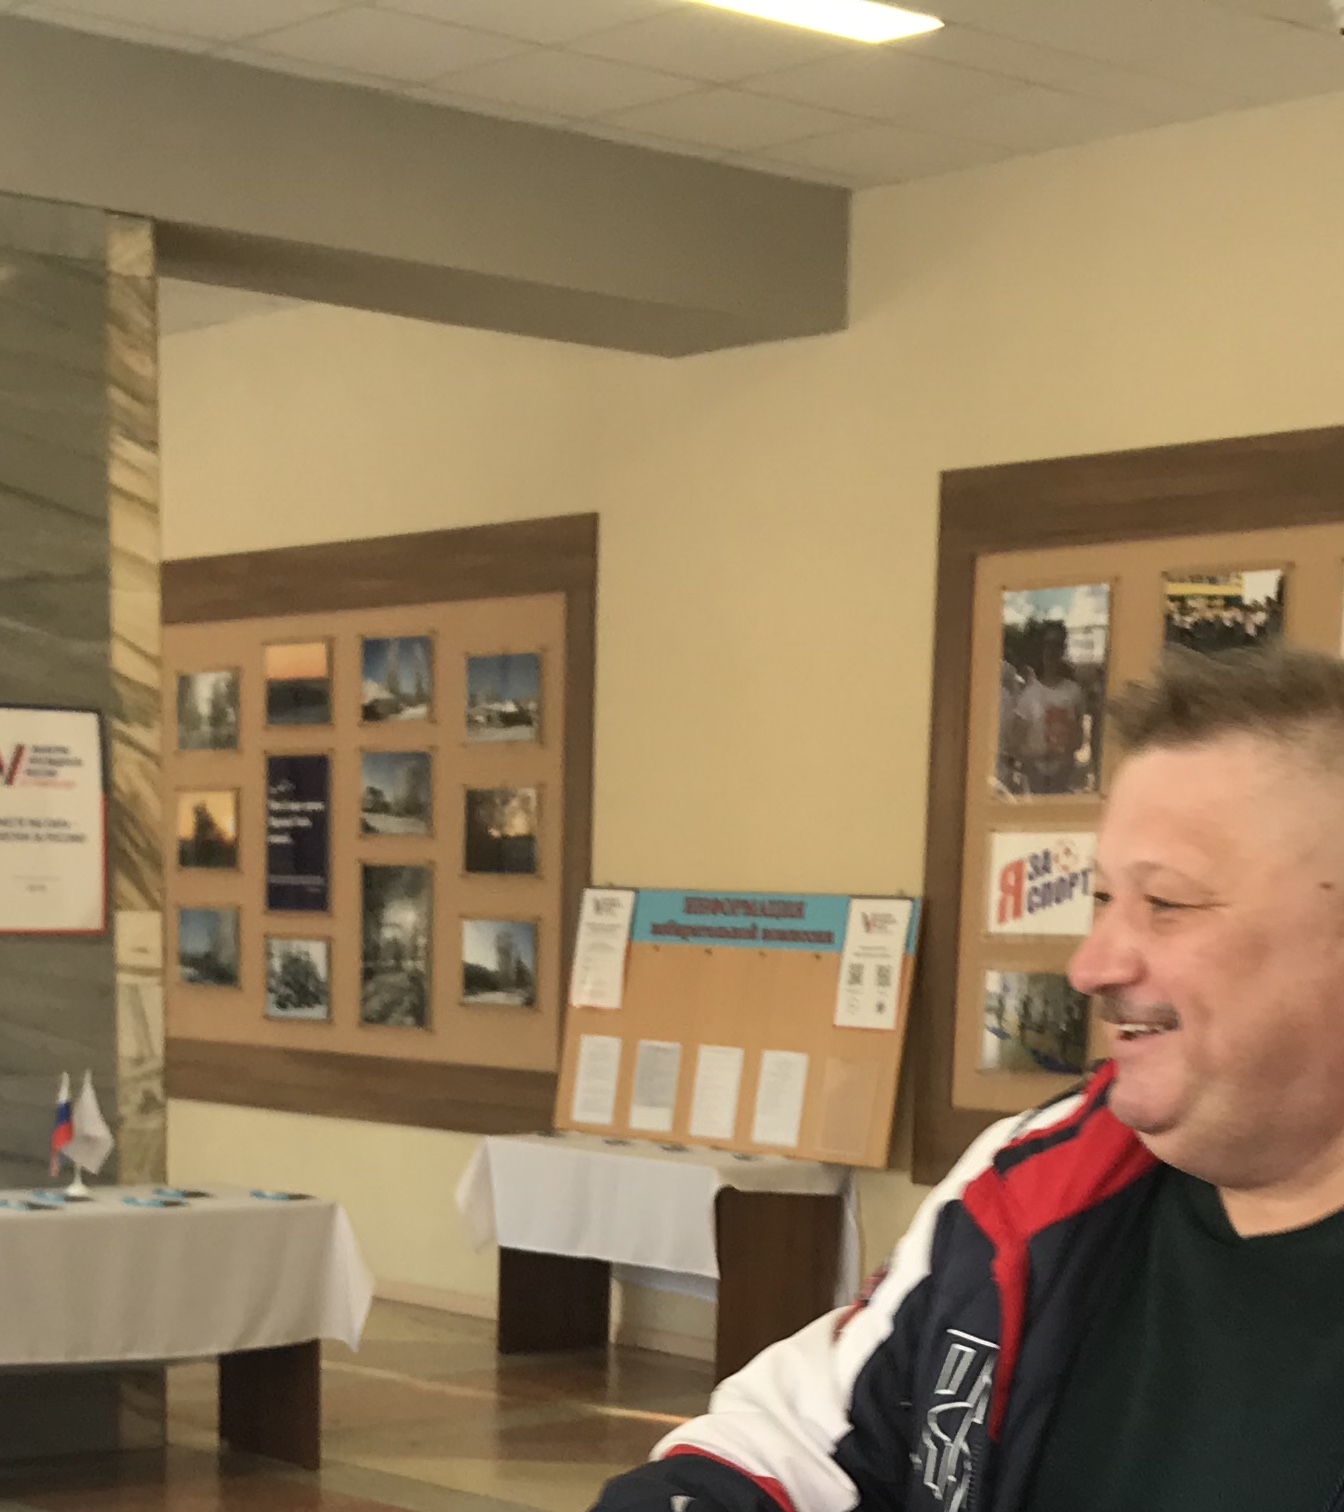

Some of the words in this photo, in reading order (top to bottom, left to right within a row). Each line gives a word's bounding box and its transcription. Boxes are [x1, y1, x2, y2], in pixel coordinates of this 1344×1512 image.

[1028, 848, 1052, 881] ЗА
[998, 857, 1025, 925] Я
[1027, 867, 1093, 915] СПОРТ
